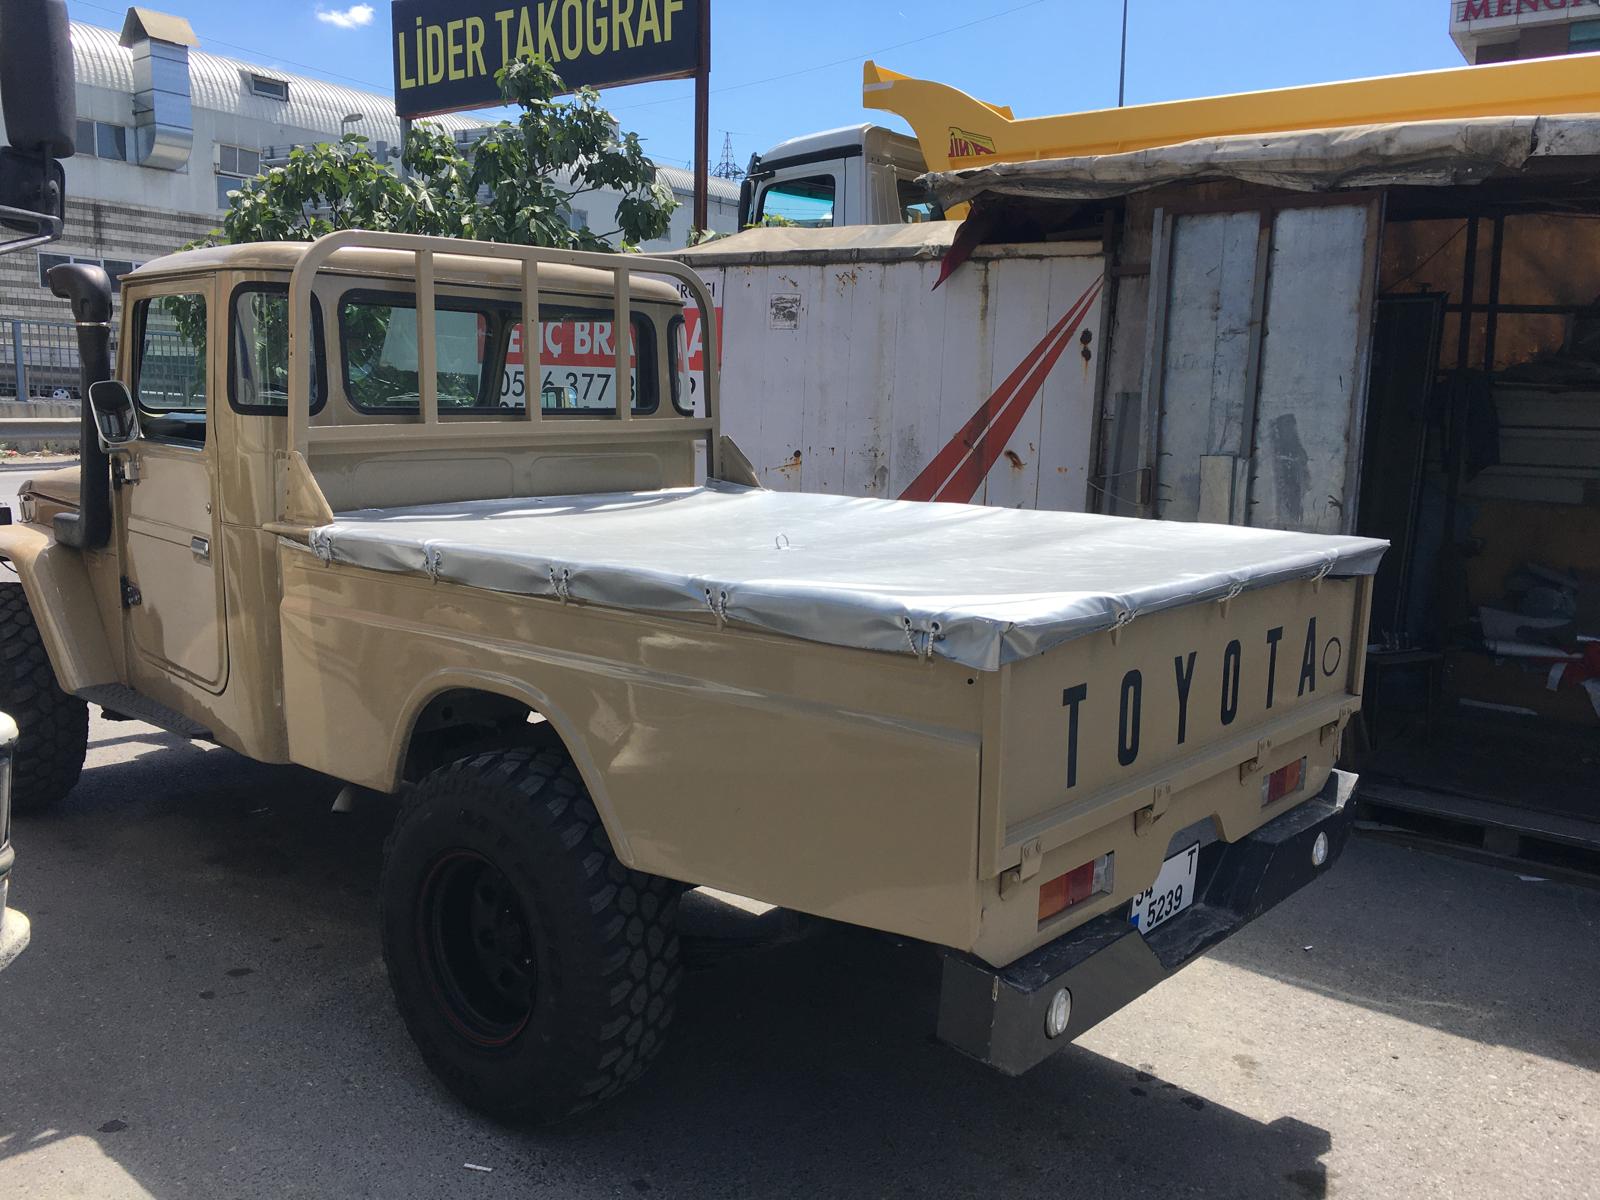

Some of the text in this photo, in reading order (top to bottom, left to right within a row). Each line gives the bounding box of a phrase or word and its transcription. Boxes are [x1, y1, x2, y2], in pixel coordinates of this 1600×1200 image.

[398, 0, 684, 89] LİDER TAKOGRAF
[1062, 616, 1316, 788] TOYOTA
[1187, 848, 1196, 875] T
[1146, 884, 1183, 927] 5239
